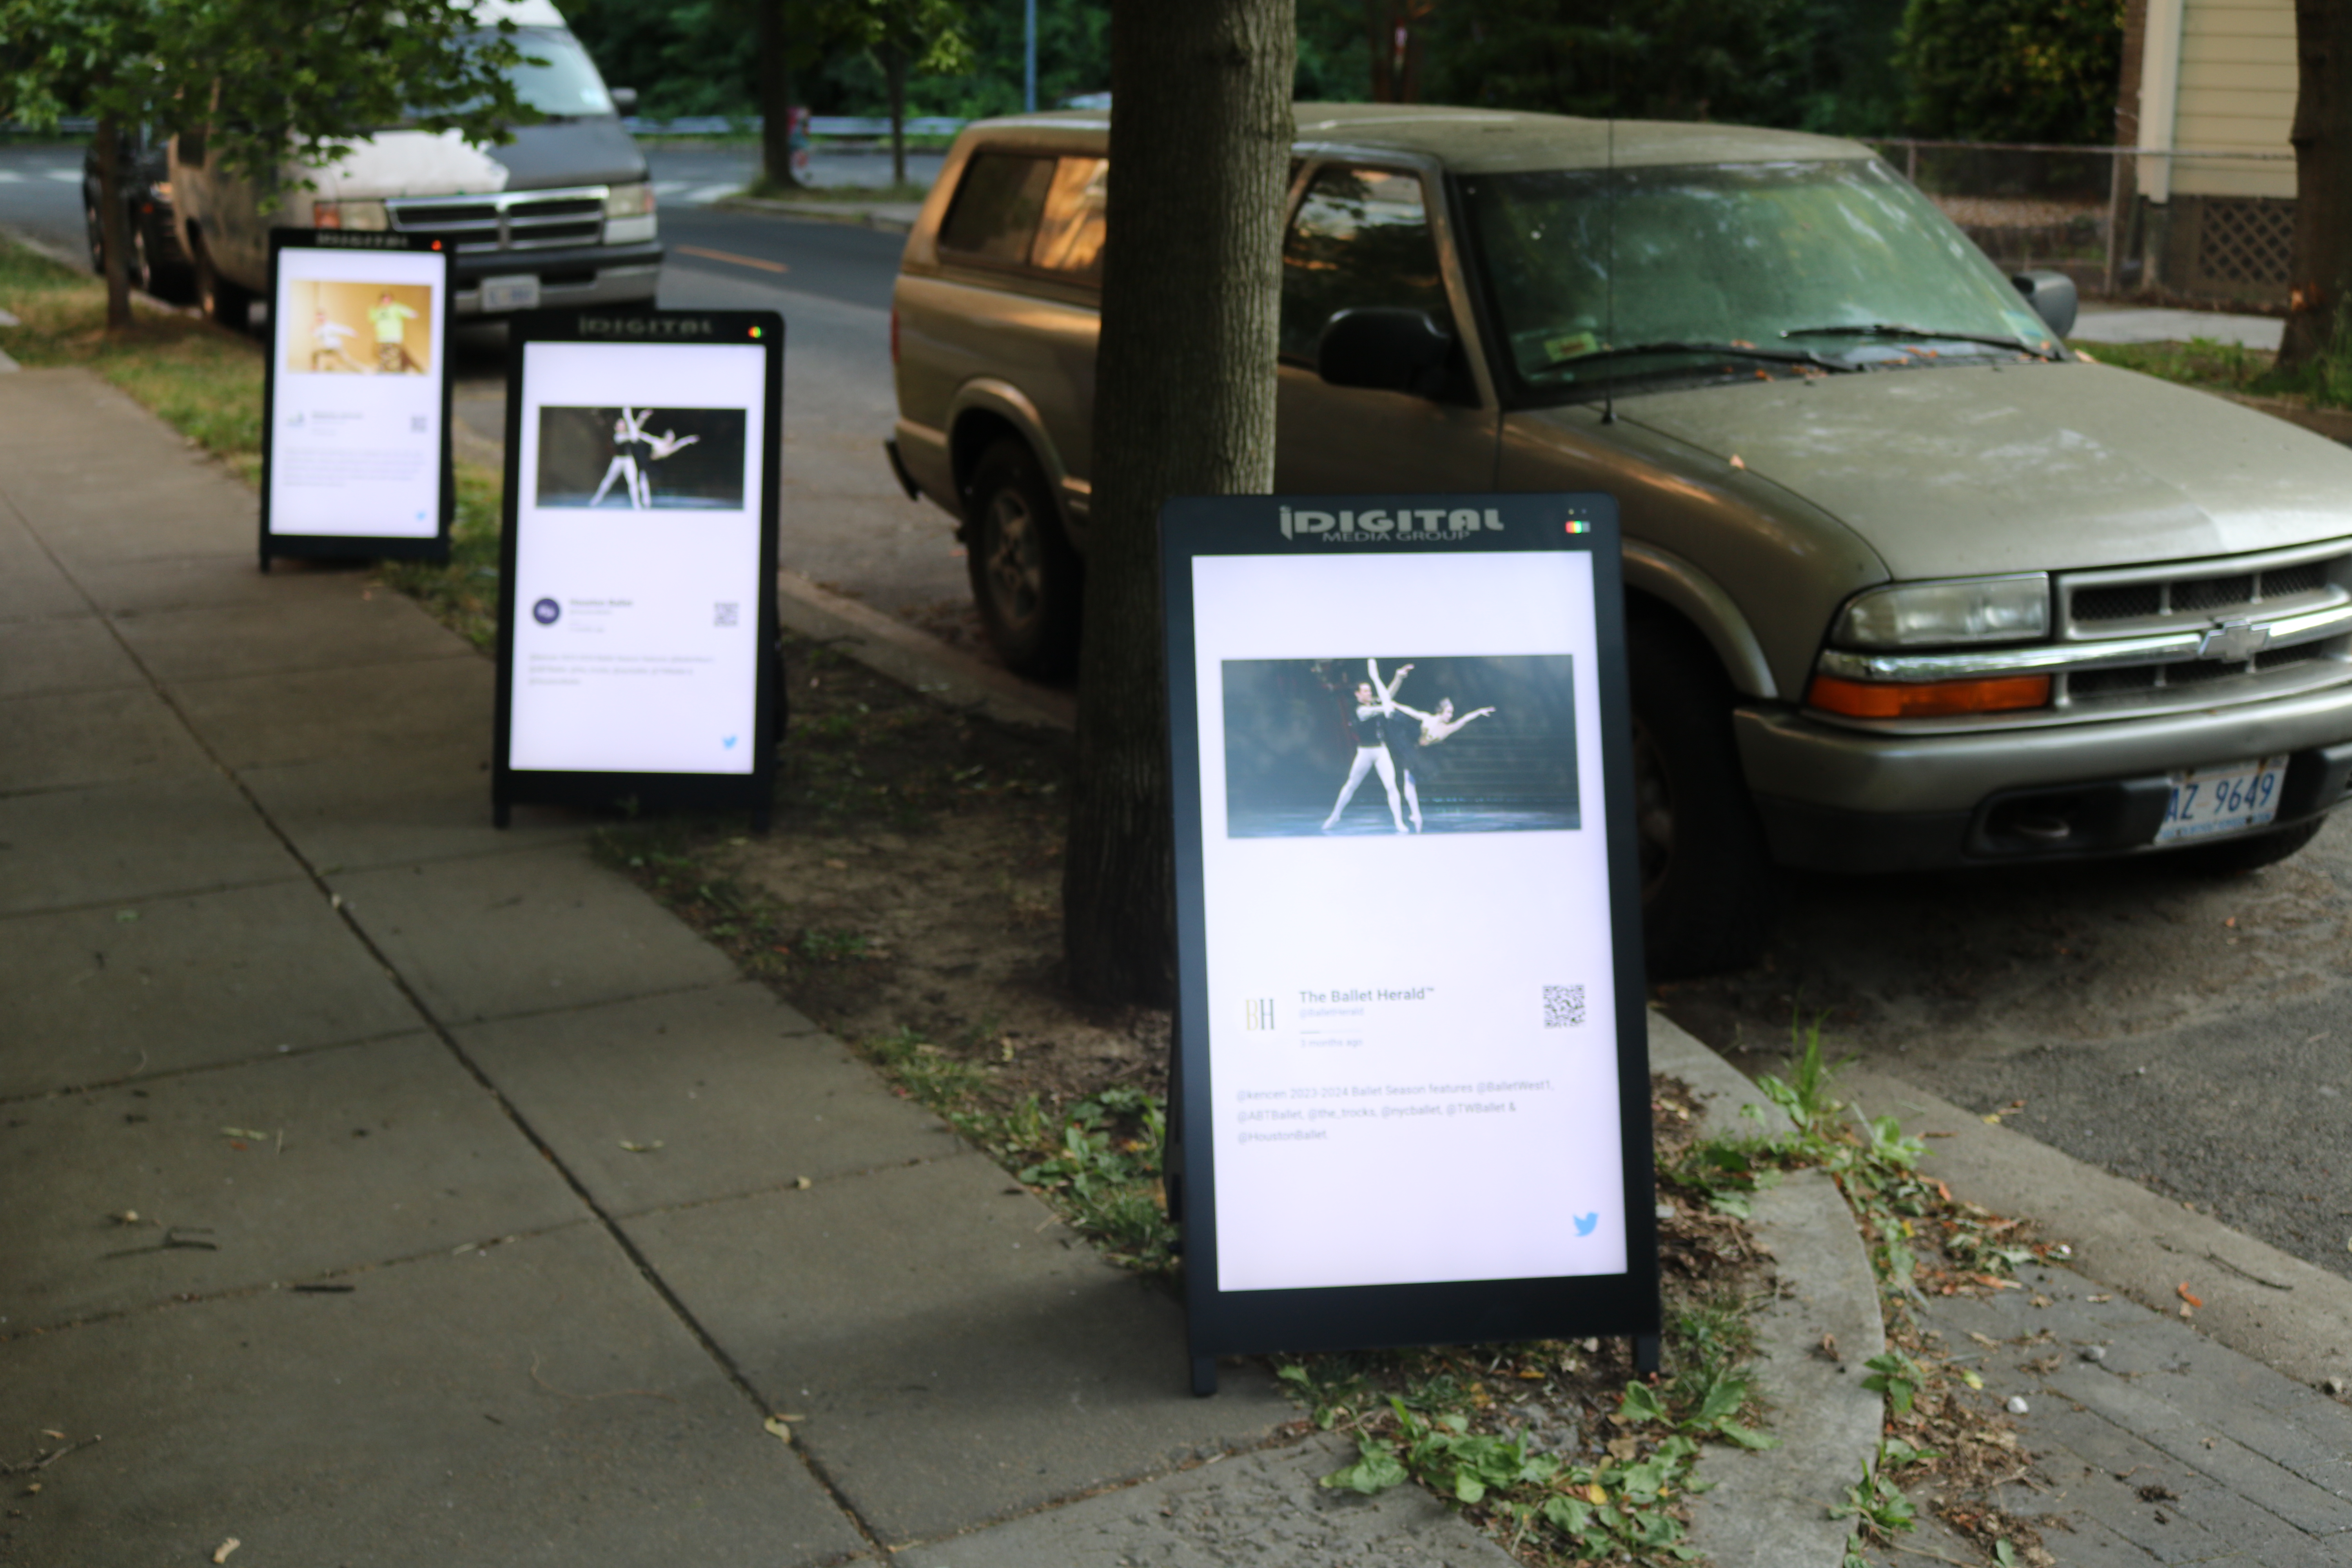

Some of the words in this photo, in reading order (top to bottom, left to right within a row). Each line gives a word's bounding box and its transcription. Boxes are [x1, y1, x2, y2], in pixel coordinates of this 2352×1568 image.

[1322, 531, 1391, 542] MEDIA
[1396, 530, 1471, 541] GROUP
[2214, 773, 2275, 814] 9649
[1299, 990, 1327, 1003] The
[1331, 990, 1372, 1003] Ballet
[1245, 998, 1275, 1031] BH
[1308, 1039, 1343, 1047] months
[1346, 1039, 1363, 1048] ago
[1351, 1085, 1383, 1098] Ballet
[1385, 1084, 1426, 1096] Season
[1428, 1082, 1473, 1094] features
[1508, 1101, 1516, 1112] &
